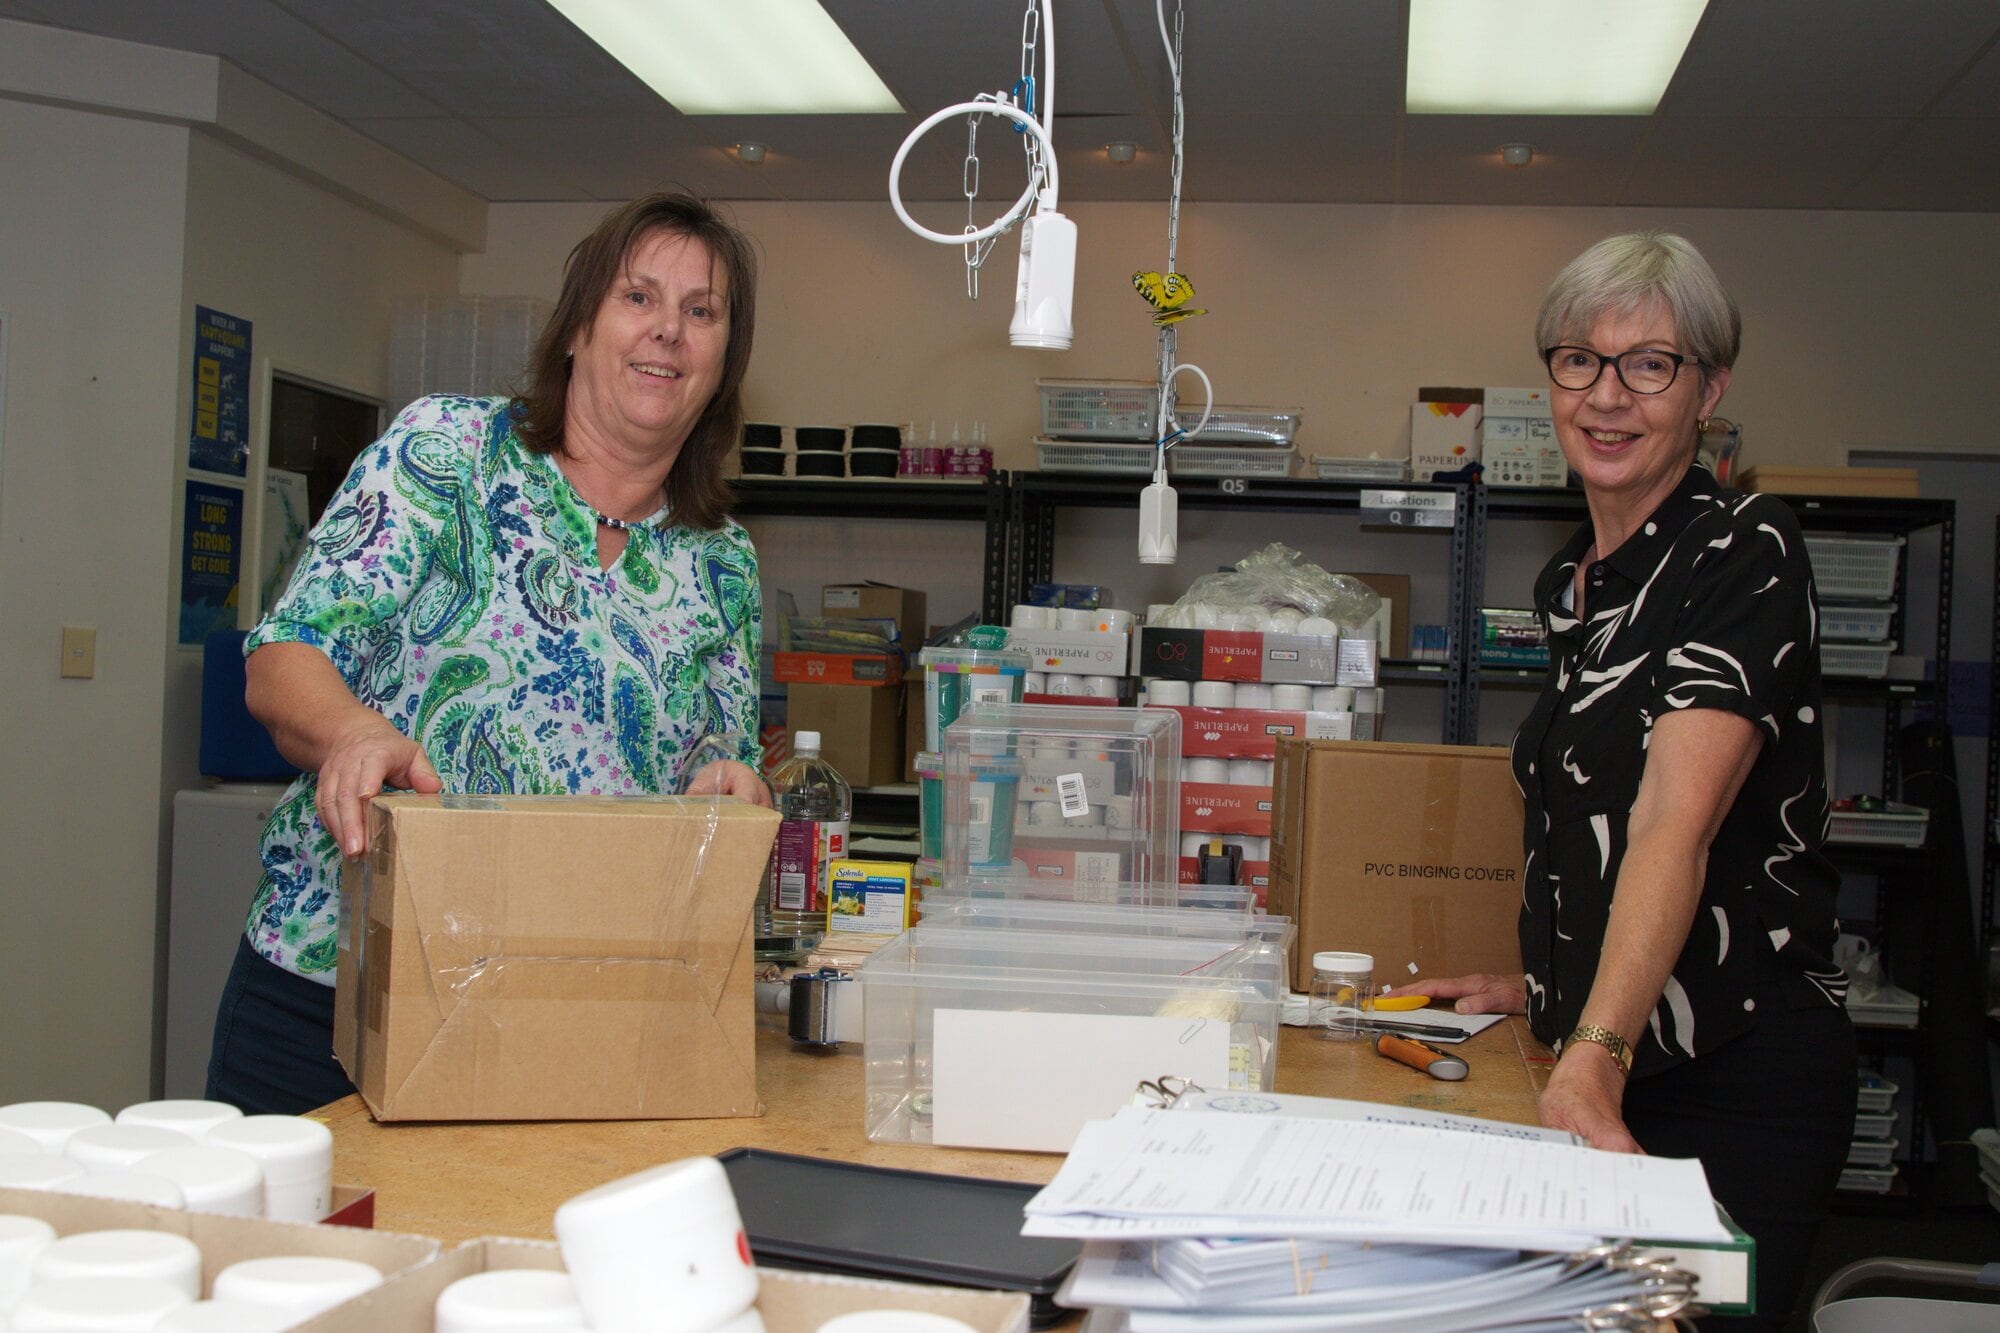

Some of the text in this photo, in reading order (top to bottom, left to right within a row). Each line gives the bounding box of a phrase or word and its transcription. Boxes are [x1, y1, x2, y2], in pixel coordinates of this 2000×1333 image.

[1222, 479, 1245, 495] Q5
[1380, 495, 1437, 506] Locations
[201, 504, 227, 525] LONG
[1389, 511, 1424, 525] Q R
[192, 530, 232, 553] STRONG
[191, 556, 232, 574] GET GONE
[1035, 646, 1089, 658] PAPERLINE
[1208, 646, 1257, 656] PAPERLINE
[1193, 720, 1249, 732] PAPERLINE
[1185, 796, 1241, 808] PAPERLINE
[836, 868, 864, 878] Splenda
[1364, 863, 1516, 882] PVC BINGING COVER
